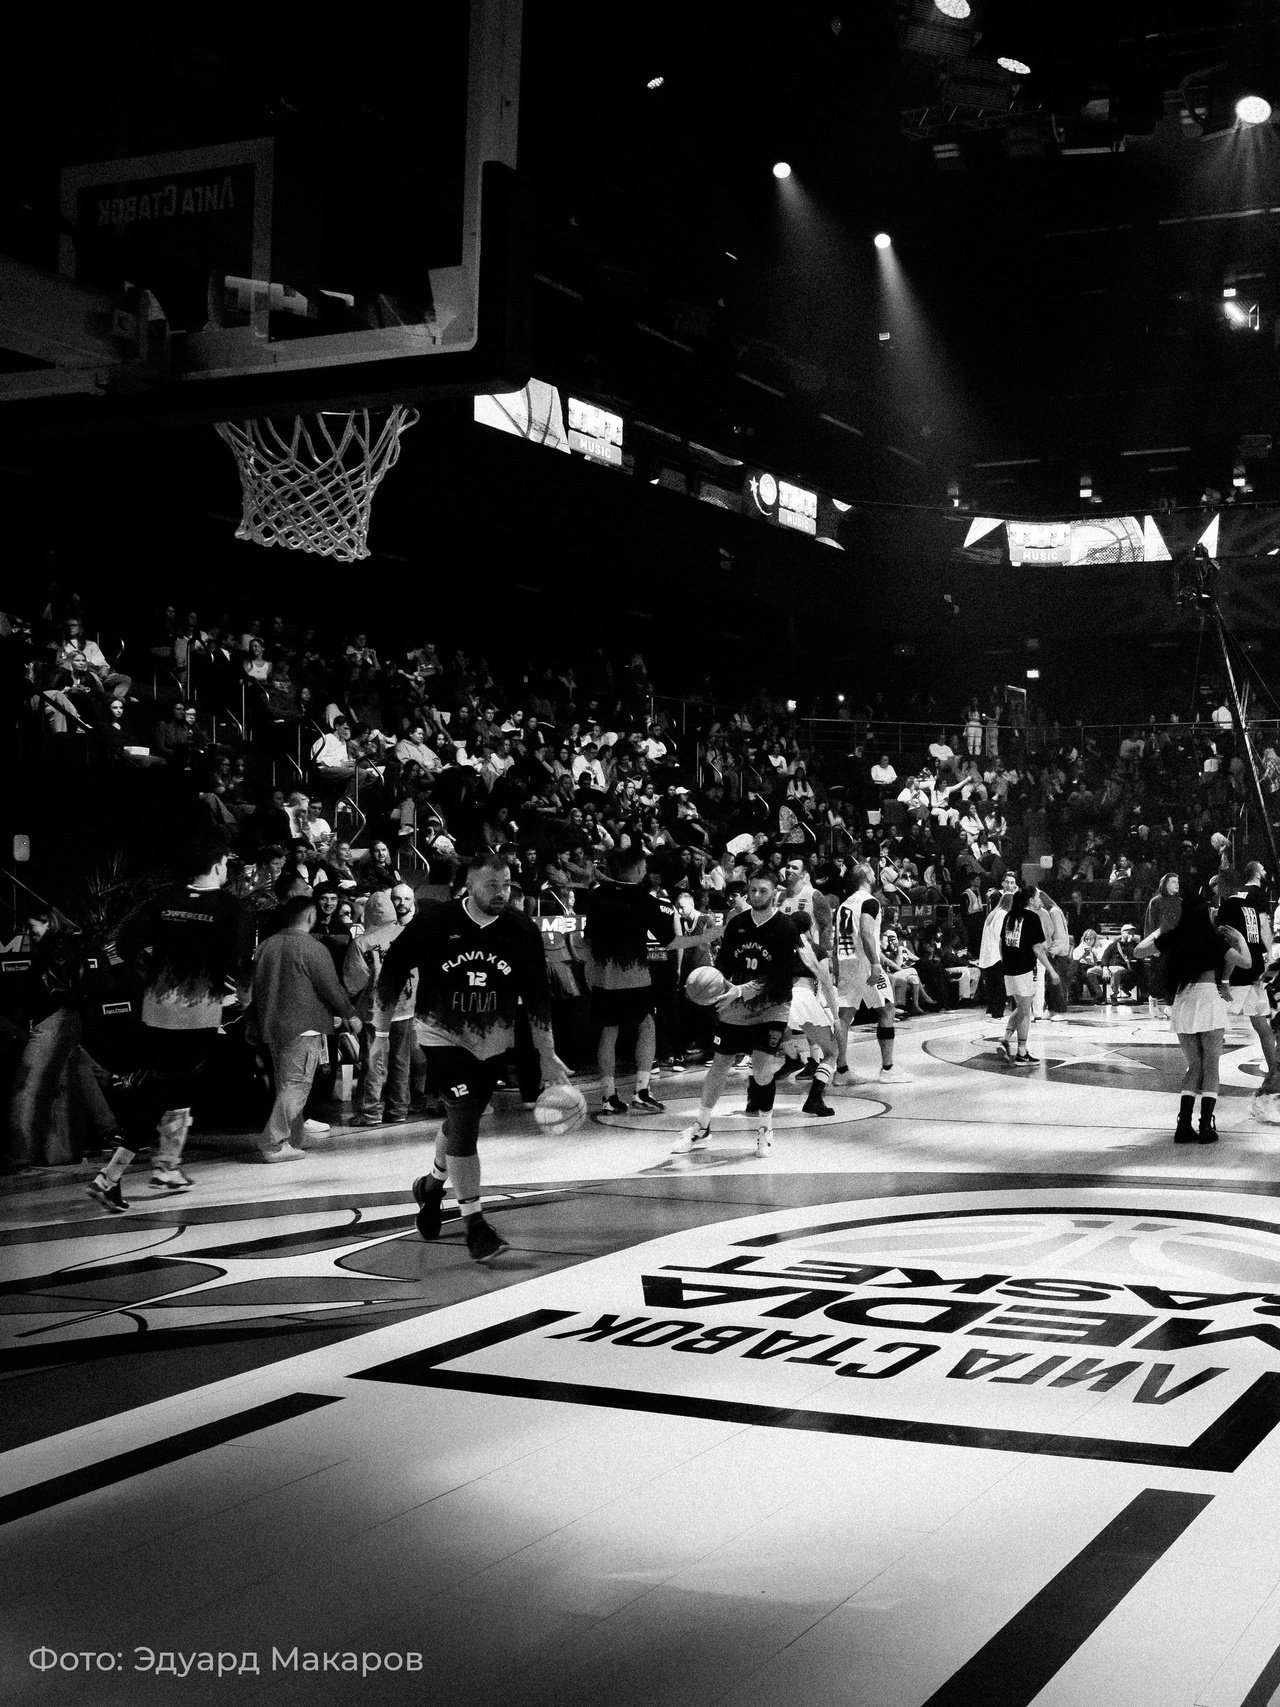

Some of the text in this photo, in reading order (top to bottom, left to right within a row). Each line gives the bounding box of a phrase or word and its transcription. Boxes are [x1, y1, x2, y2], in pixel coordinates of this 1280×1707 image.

[579, 438, 612, 460] MUSIC
[786, 512, 810, 531] MUSIC
[1022, 551, 1058, 560] MUSIC
[441, 950, 513, 976] FLAVA X QB
[745, 956, 759, 971] 10
[466, 970, 488, 987] 12
[450, 1084, 469, 1098] 12
[548, 1312, 1229, 1406] ЛИГА СТАВОК
